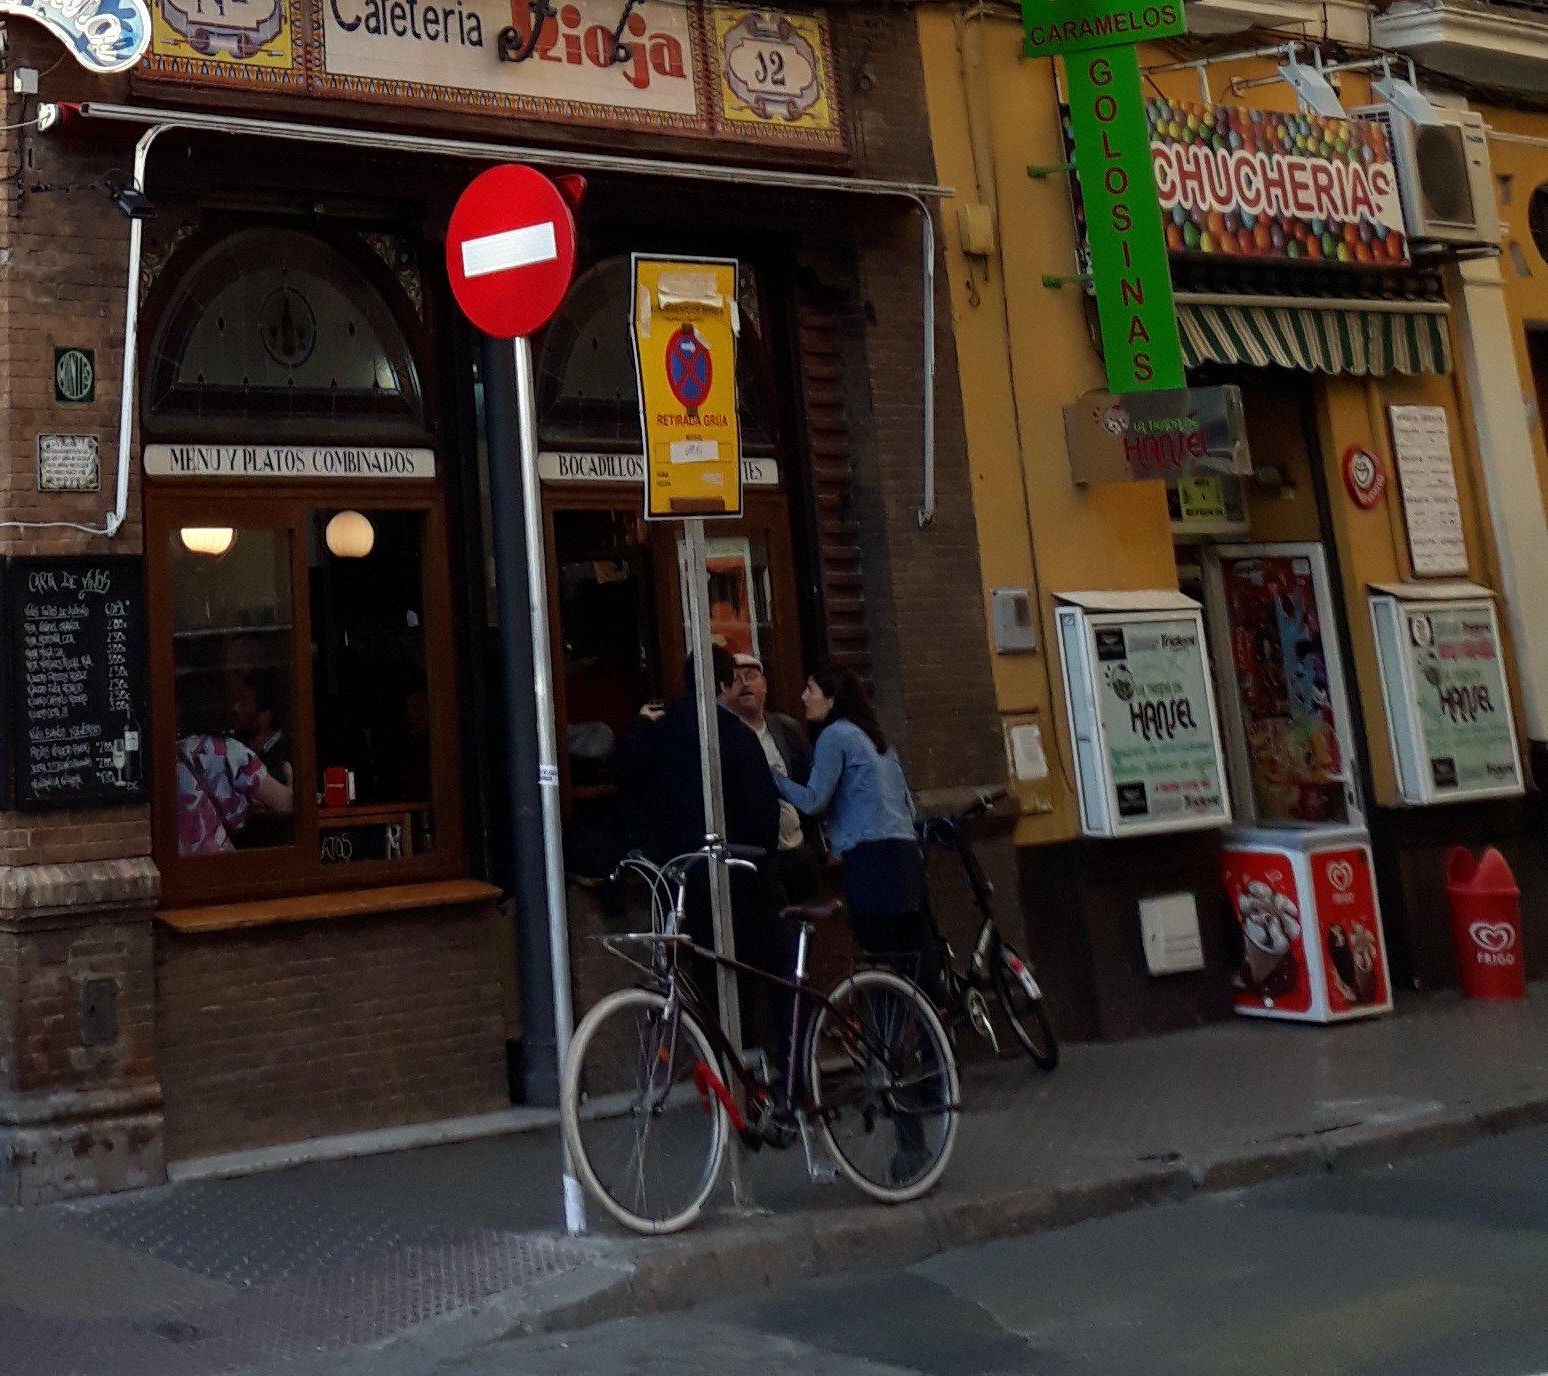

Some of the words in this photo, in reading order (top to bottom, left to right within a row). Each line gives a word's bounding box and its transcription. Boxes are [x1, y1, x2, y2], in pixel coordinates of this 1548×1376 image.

[1030, 4, 1179, 49] CARAMELOS
[1153, 146, 1392, 222] CHUCHERIAS
[1088, 58, 1155, 382] GOLOSINAS
[224, 448, 238, 471] Y
[242, 448, 306, 473] PLATOS
[312, 449, 416, 474] COMBINADOS
[558, 454, 644, 477] BOCADILLOS
